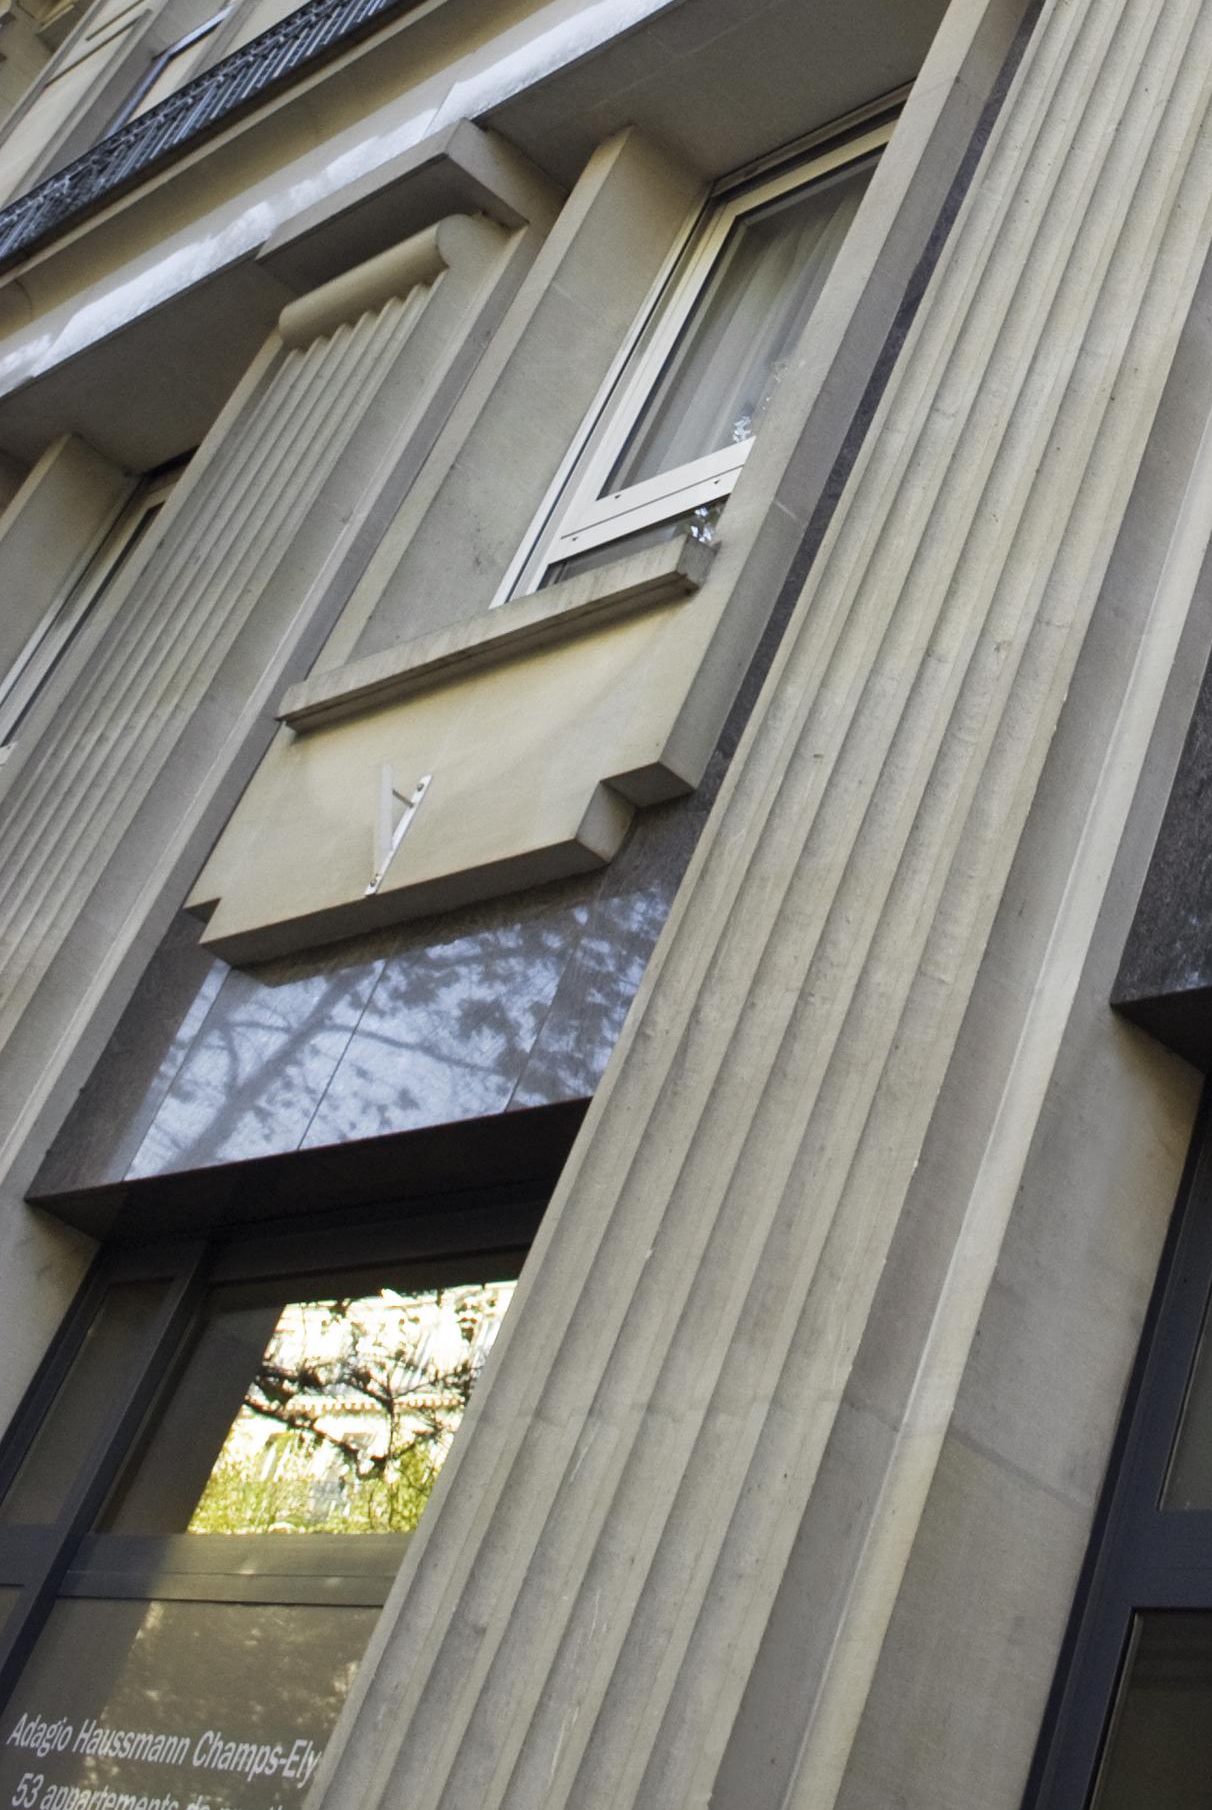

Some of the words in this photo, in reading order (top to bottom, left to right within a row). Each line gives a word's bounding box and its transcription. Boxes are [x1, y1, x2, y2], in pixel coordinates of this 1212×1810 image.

[6, 1712, 74, 1757] Adagio
[72, 1719, 191, 1765] Haussmann
[11, 1772, 45, 1808] 53
